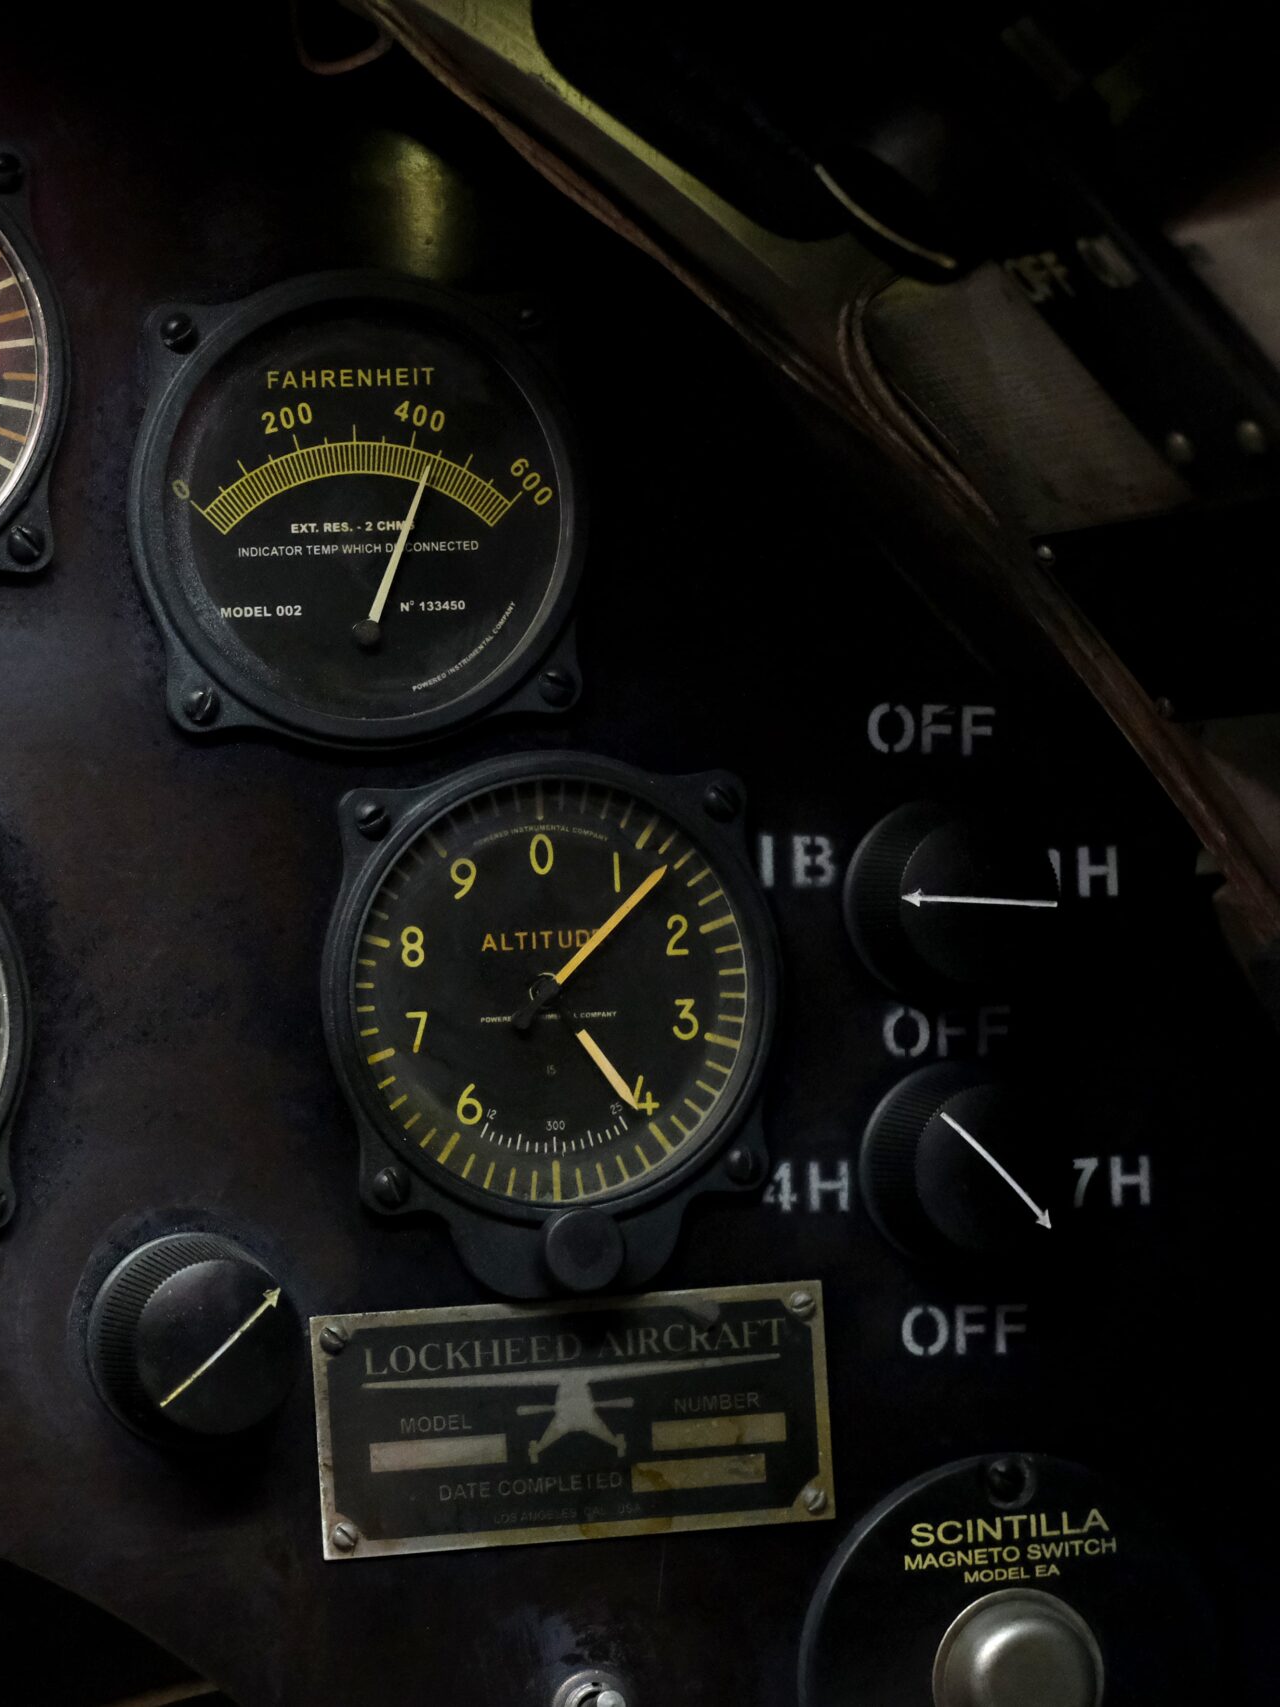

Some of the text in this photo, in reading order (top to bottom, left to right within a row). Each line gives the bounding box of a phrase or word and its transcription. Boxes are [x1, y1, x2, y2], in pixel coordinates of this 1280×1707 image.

[266, 366, 436, 390] FAHRENHEIT
[260, 401, 314, 436] 200
[393, 399, 446, 433] 400
[171, 478, 191, 501] 0
[509, 456, 554, 508] 600
[290, 523, 319, 534] EXT.
[323, 521, 354, 533] RES.
[365, 521, 373, 532] 2
[238, 540, 480, 558] INDICATOR TEMP WHICH DICONNECTED
[220, 605, 302, 619] MODEL 002
[419, 600, 466, 612] 133450
[412, 601, 516, 692] POWERED INSTRUMENTAL COMPANY
[867, 702, 997, 757] OFF
[511, 824, 570, 835] INSTRUMENTAL
[572, 827, 609, 842] COMPANY
[529, 833, 554, 876] 0
[613, 851, 621, 893] 1
[450, 857, 477, 900] 9
[400, 925, 425, 969] 8
[666, 913, 690, 957] 2
[405, 1011, 428, 1054] 7
[480, 1015, 512, 1025] POWERE
[579, 1010, 617, 1020] COMPANY
[672, 997, 699, 1041] 3
[882, 1005, 1011, 1058] OFF
[456, 1082, 483, 1126] 6
[610, 1102, 623, 1115] 25
[632, 1074, 661, 1116] 4
[486, 1109, 497, 1120] 12
[545, 1121, 566, 1131] 300
[763, 1159, 851, 1213] 4H
[1072, 1154, 1153, 1208] 7H
[901, 1303, 1028, 1356] OFF
[364, 1317, 787, 1378] LOCKHEED AIRCRAFT
[673, 1391, 760, 1413] NUMBER
[399, 1413, 472, 1434] MODEL
[439, 1471, 622, 1501] DATE COMPLETED
[494, 1512, 517, 1525] LOS
[910, 1508, 1111, 1548] SCINTILLA
[903, 1536, 1117, 1571] MAGNETO SWITCH
[963, 1564, 1061, 1584] MODEL EA
